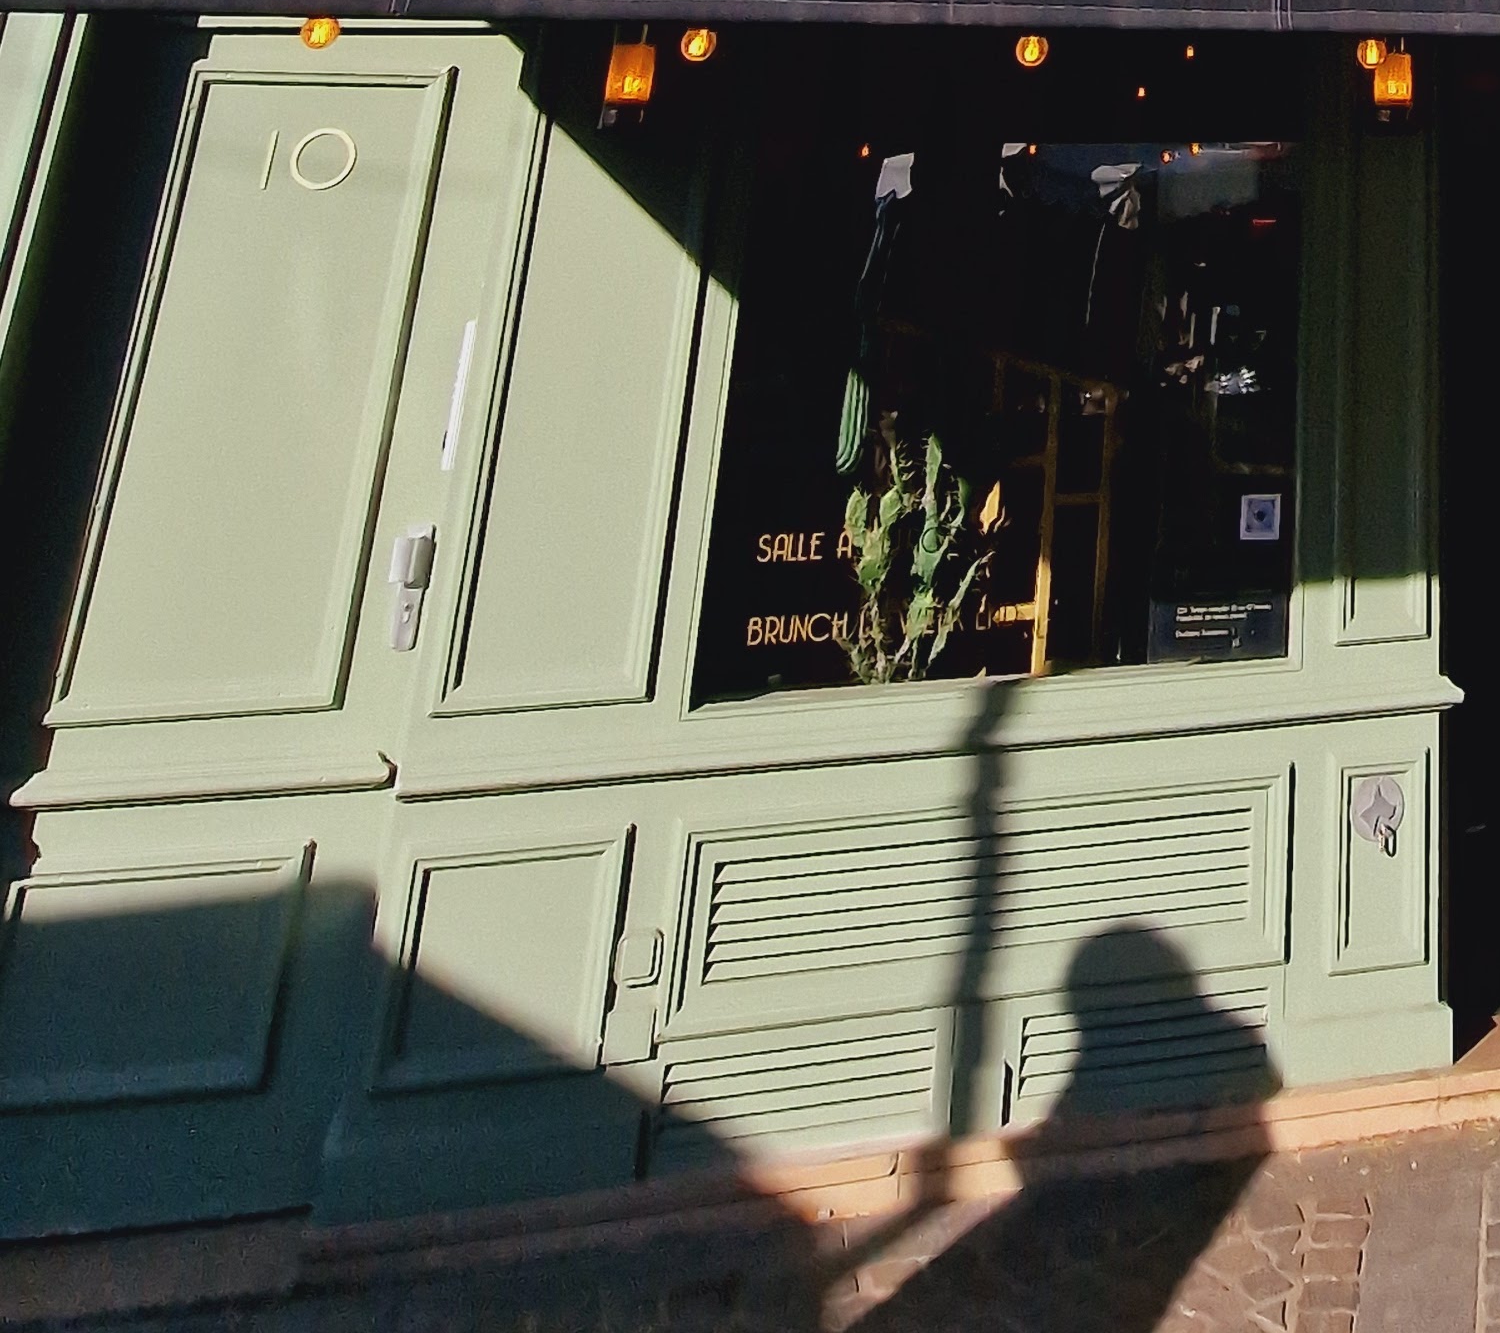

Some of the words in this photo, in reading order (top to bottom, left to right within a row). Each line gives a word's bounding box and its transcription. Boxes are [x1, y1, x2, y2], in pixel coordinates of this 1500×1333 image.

[261, 128, 356, 190] 10
[756, 532, 825, 563] SALLE
[746, 612, 849, 646] BRUNCH
